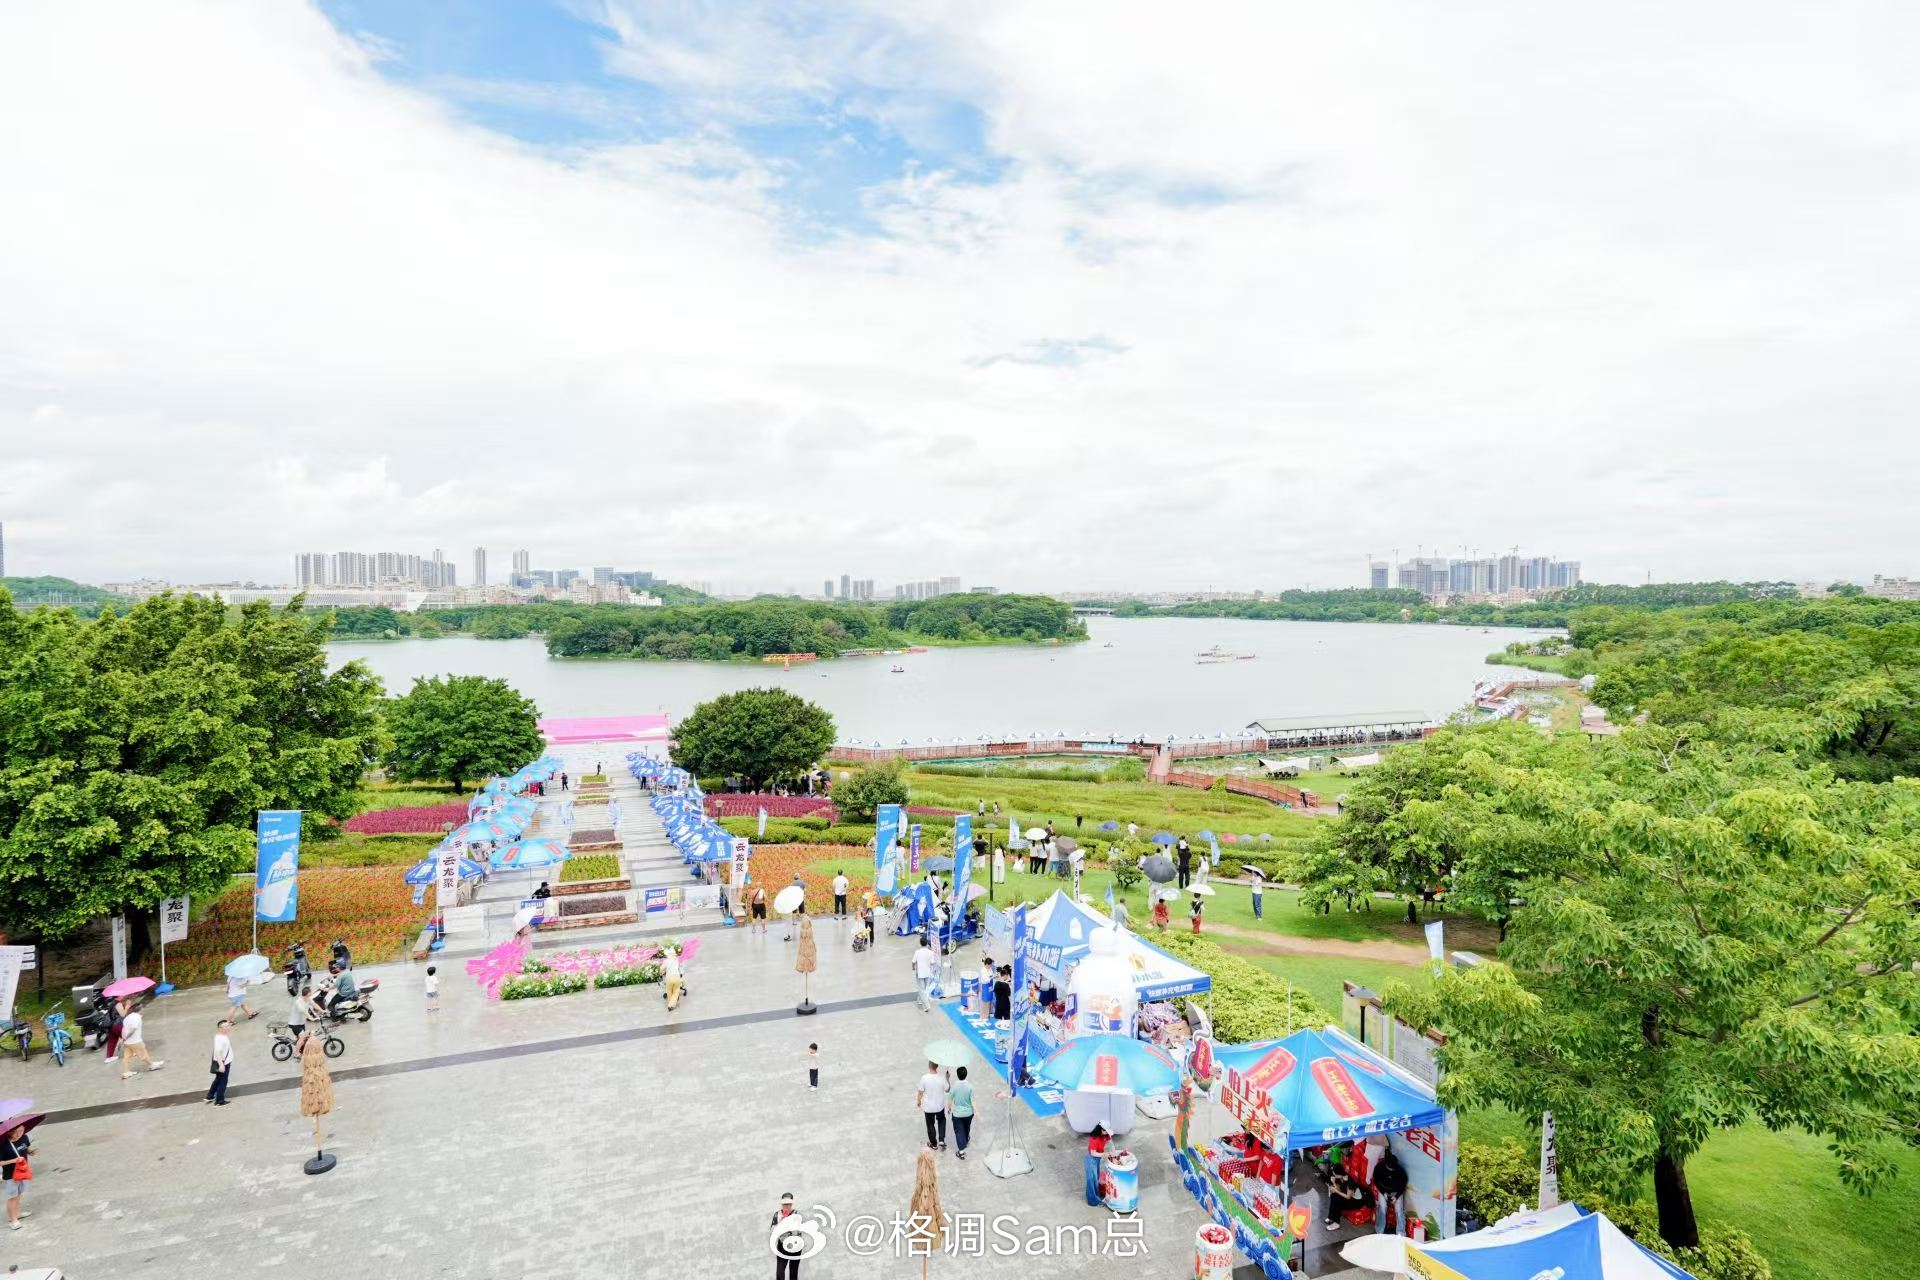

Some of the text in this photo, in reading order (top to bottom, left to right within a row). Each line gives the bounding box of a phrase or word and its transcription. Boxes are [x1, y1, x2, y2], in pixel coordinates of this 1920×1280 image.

[442, 856, 457, 888] 云龙聚
[735, 843, 746, 873] 云龙聚
[1229, 1067, 1273, 1117] 怕上火
[1221, 1084, 1275, 1149] 喝王老吉
[1322, 1114, 1413, 1141] 怕上火 喝王老吉
